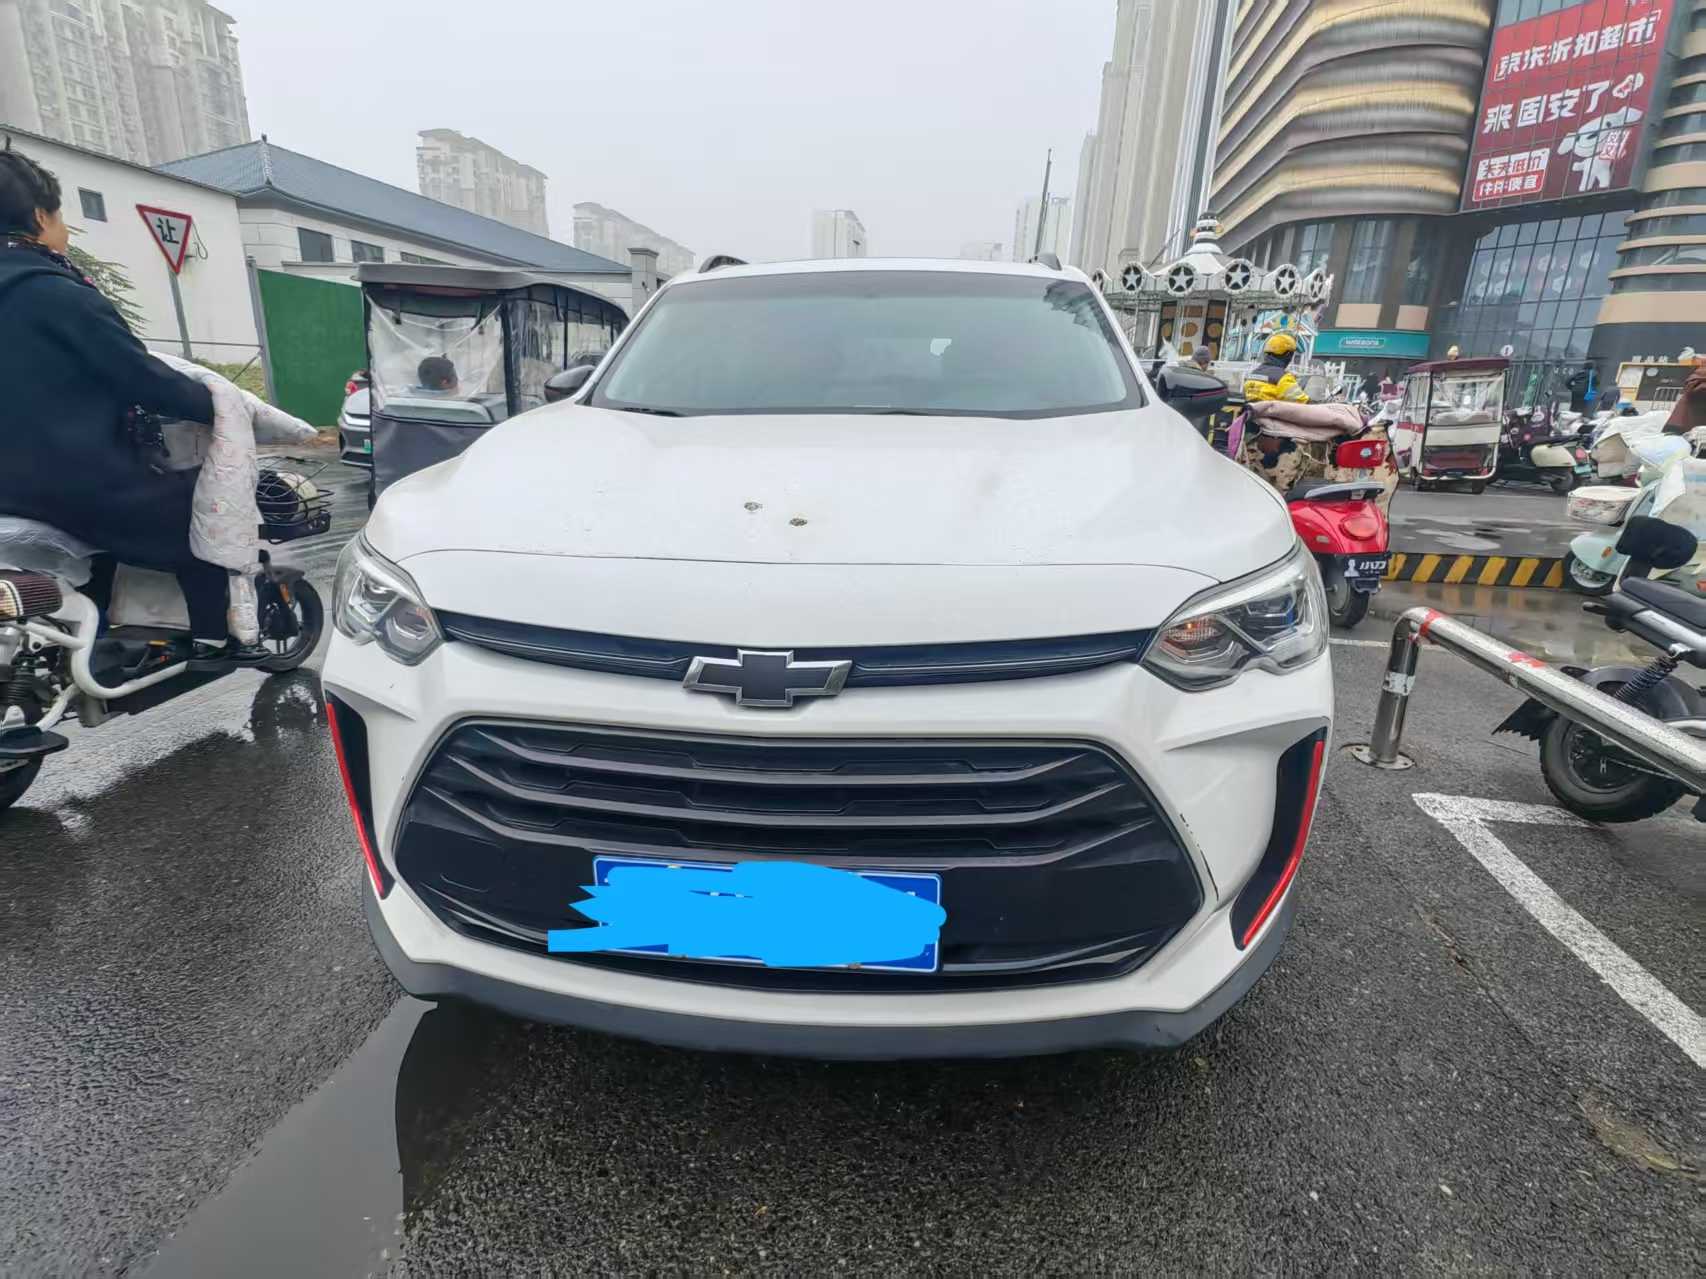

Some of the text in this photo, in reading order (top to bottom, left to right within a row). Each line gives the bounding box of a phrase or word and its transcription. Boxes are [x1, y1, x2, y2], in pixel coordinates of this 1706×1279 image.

[1482, 80, 1613, 134] 来固安了
[156, 217, 180, 245] 让
